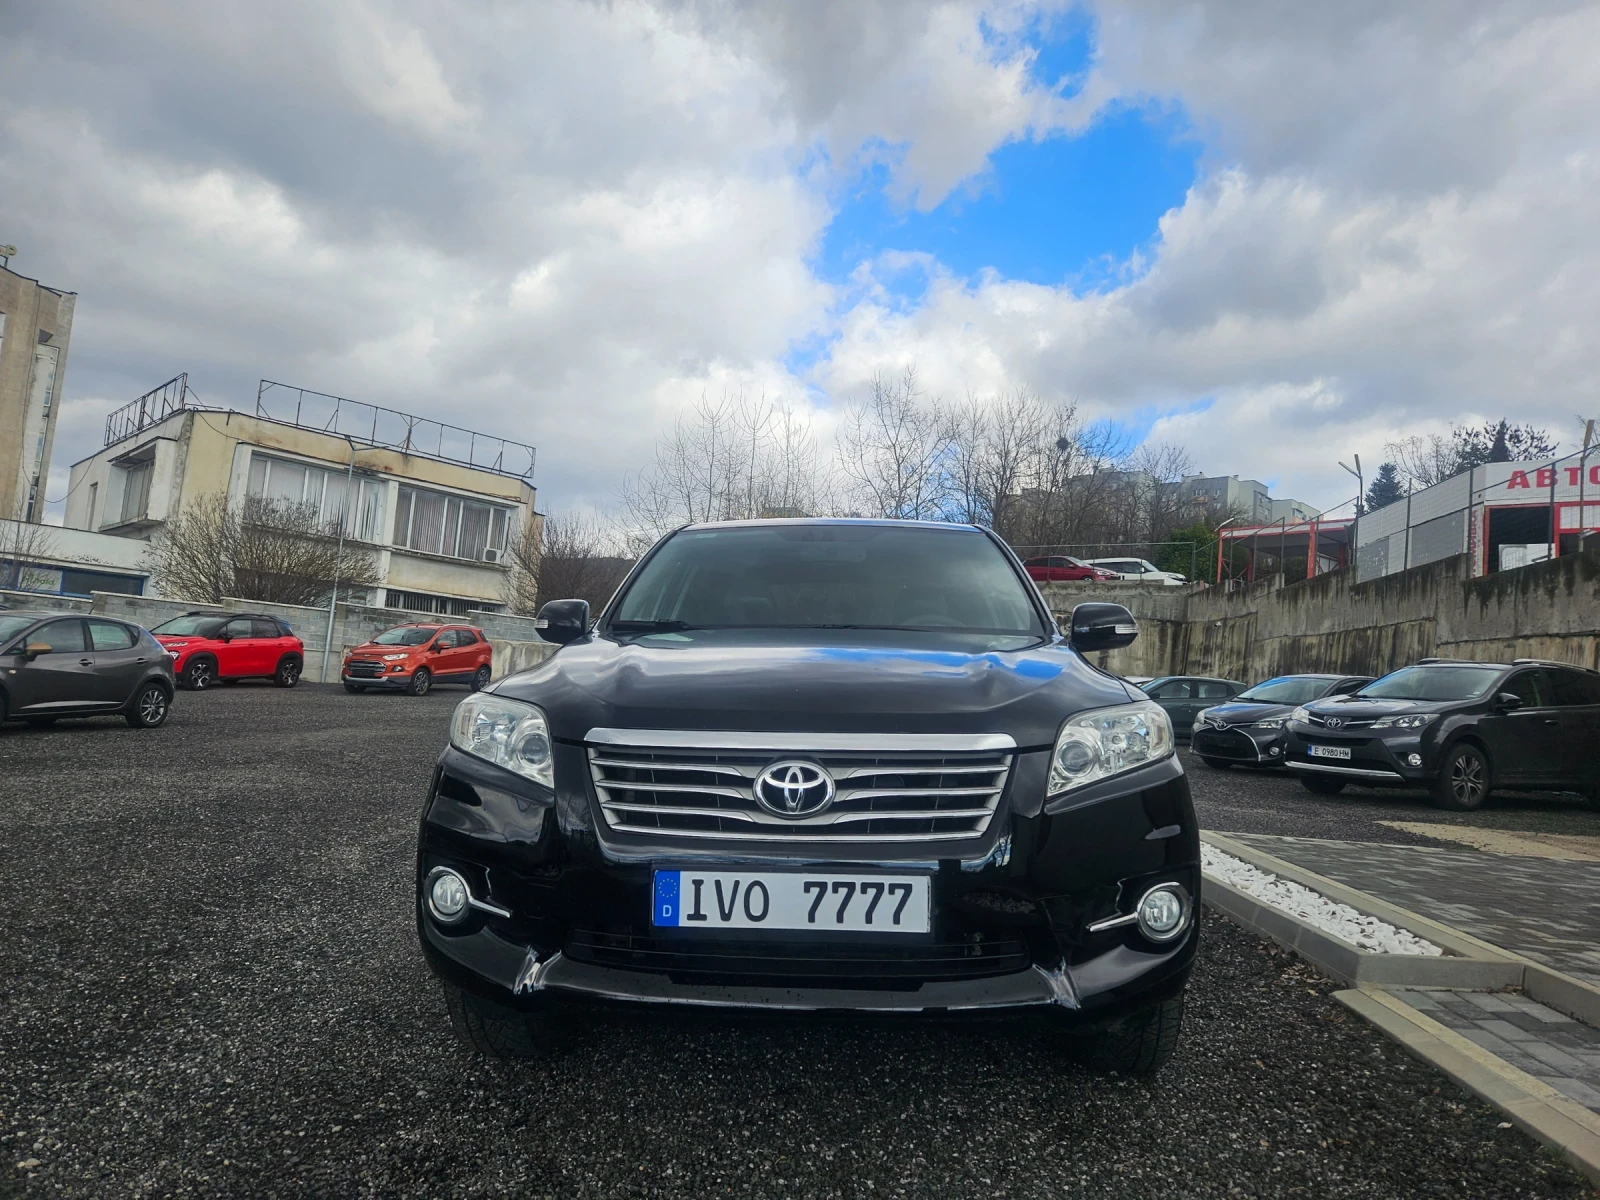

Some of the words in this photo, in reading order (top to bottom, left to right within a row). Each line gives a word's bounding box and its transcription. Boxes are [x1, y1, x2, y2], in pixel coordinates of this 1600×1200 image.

[1322, 748, 1338, 756] 0980
[662, 905, 672, 917] D
[687, 879, 770, 922] IVO
[803, 881, 913, 925] 7777
